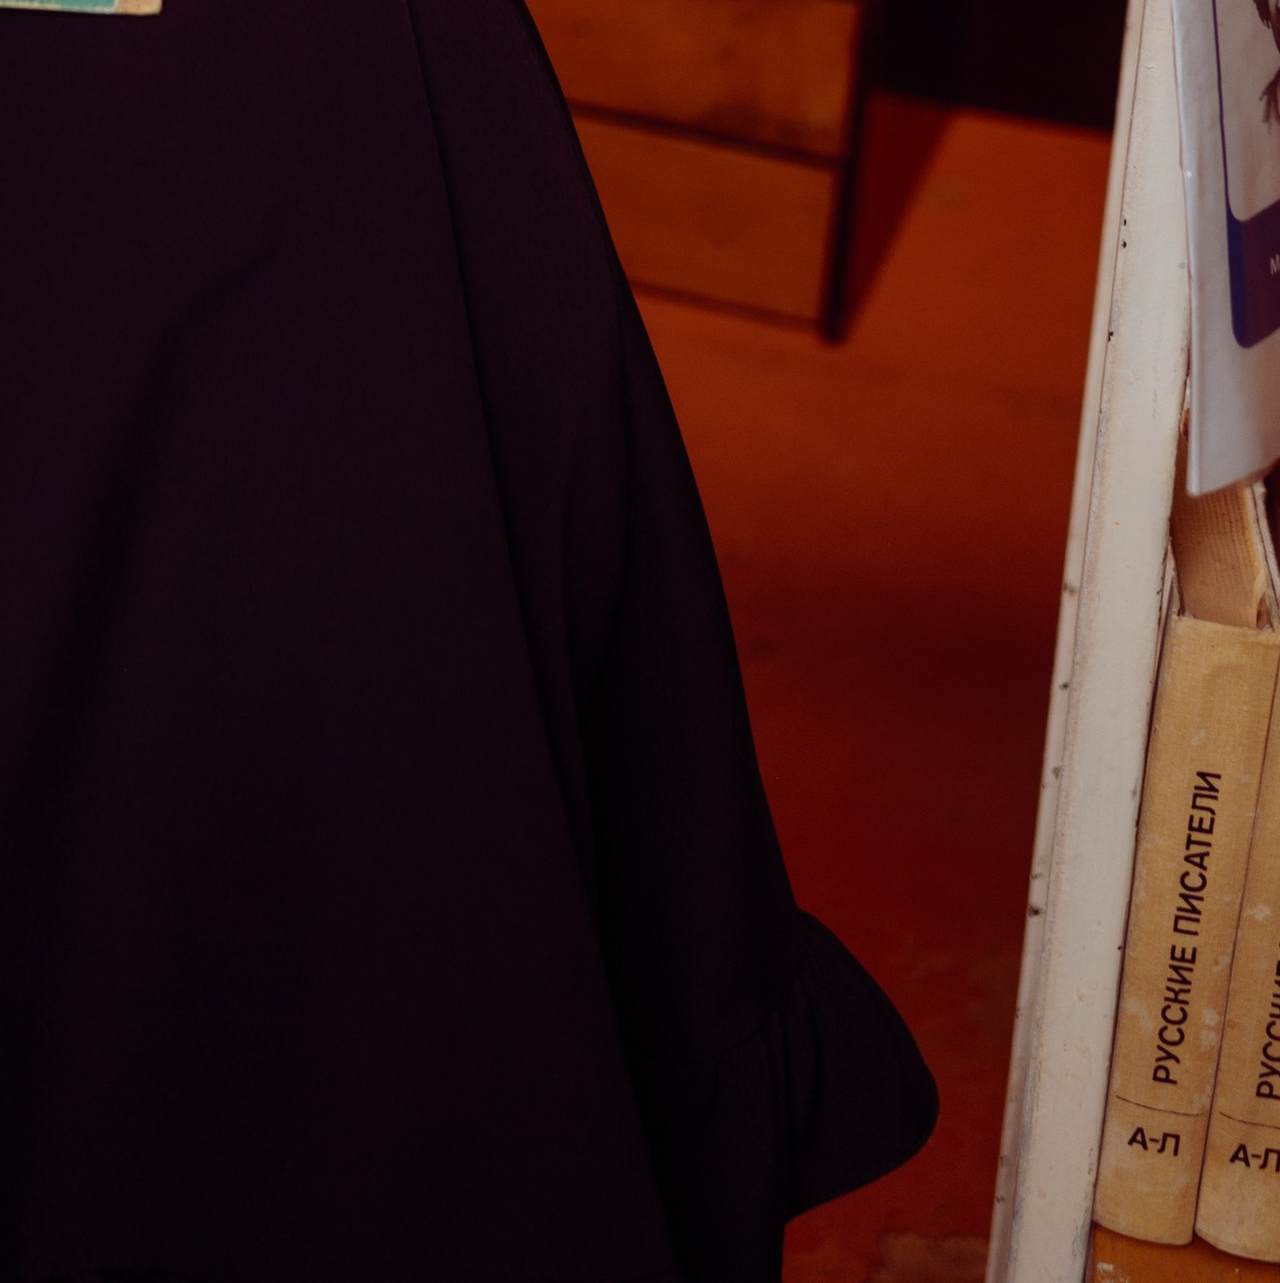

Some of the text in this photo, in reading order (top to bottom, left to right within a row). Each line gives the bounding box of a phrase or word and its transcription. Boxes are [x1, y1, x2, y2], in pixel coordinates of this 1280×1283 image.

[1152, 770, 1222, 1086] РУССКИЕ ПИСАТЕЛИ
[1127, 1126, 1181, 1157] А-Л
[1229, 1143, 1280, 1173] А-Л
